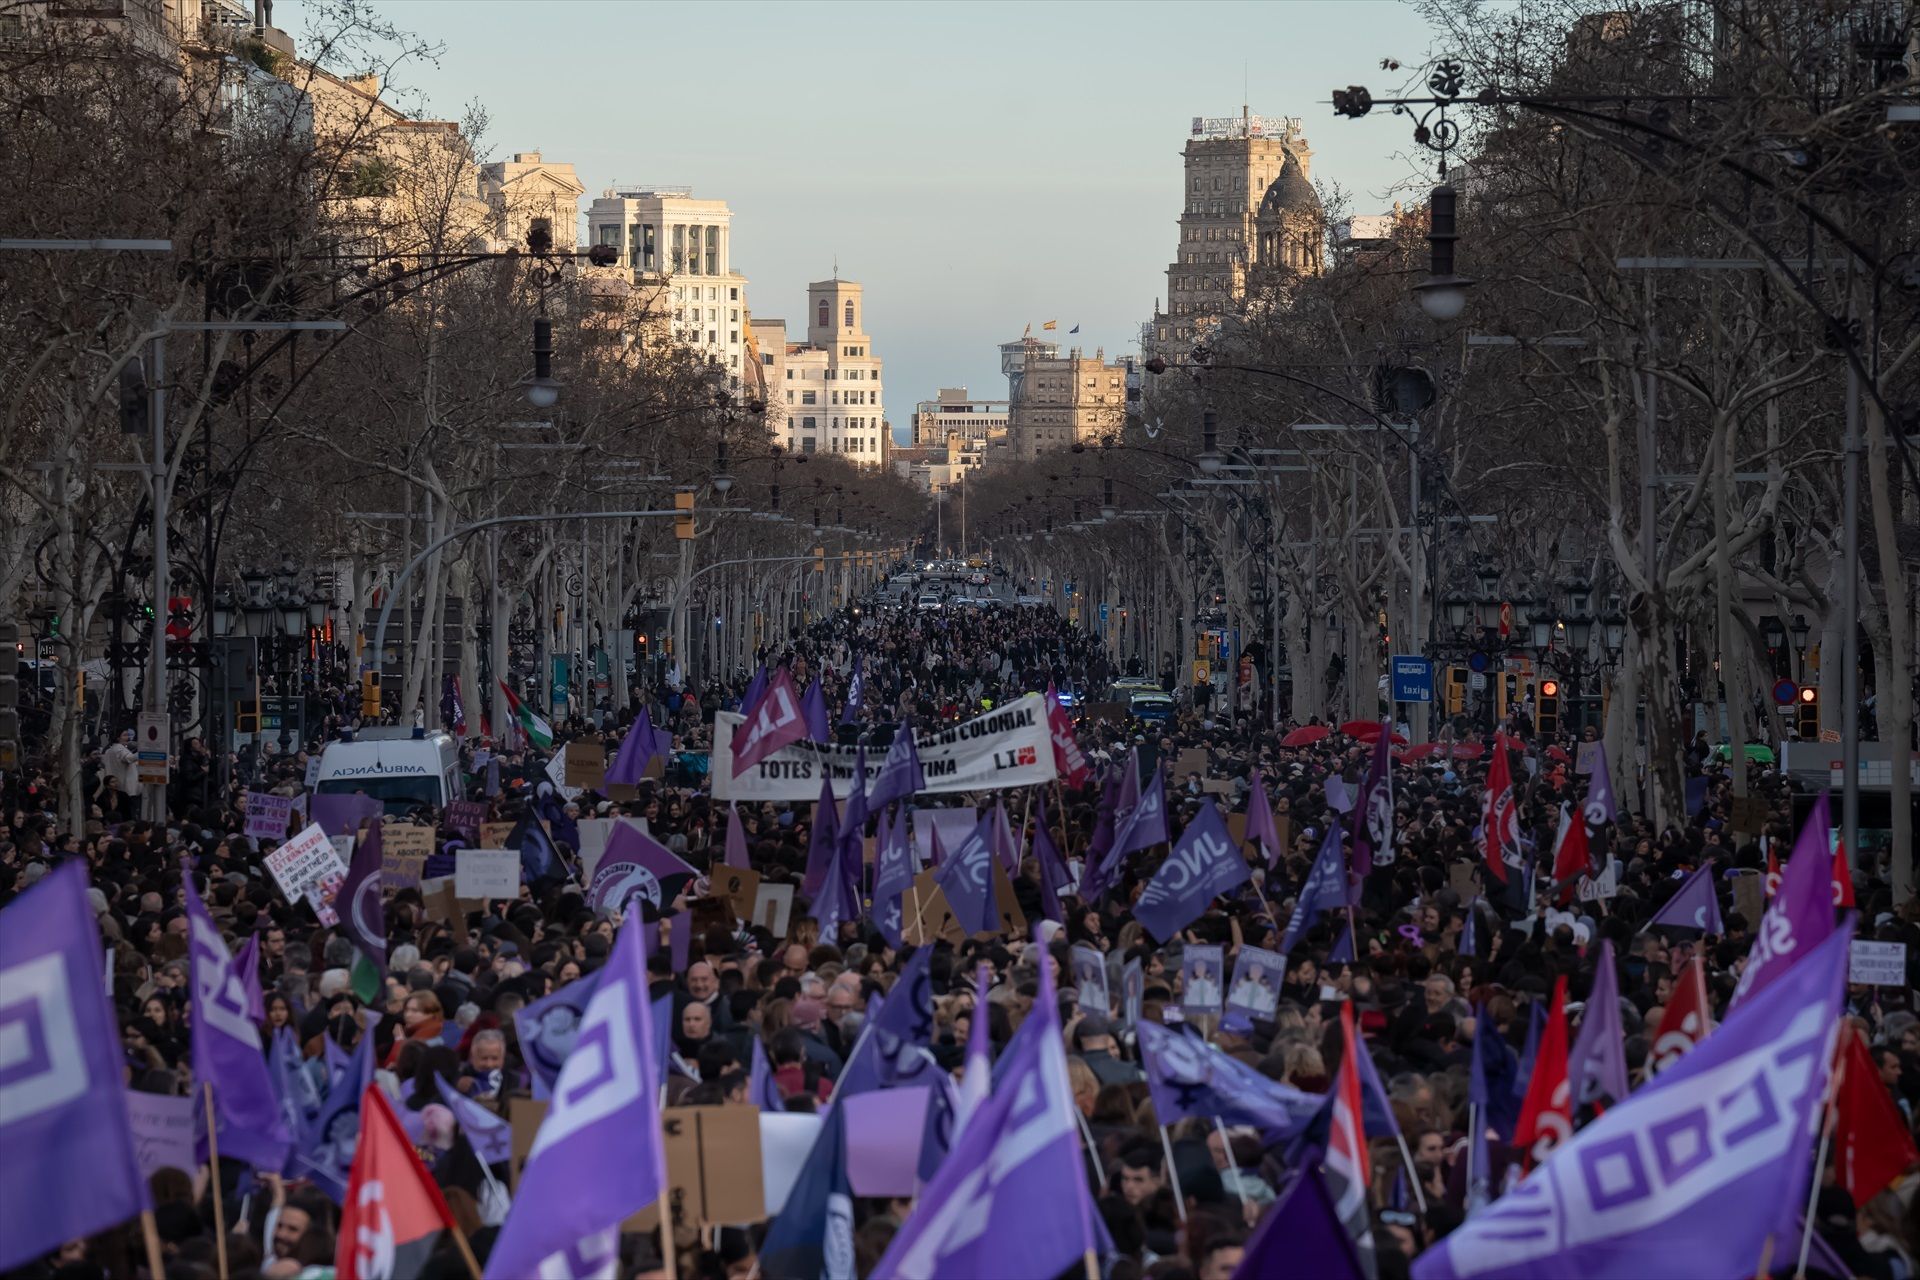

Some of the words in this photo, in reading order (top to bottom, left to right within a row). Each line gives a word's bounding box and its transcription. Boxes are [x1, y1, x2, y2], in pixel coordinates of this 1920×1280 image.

[1403, 685, 1420, 695] taxi
[959, 707, 1036, 740] COLONIAL
[760, 761, 812, 779] TOTES
[450, 800, 481, 815] TODO
[268, 850, 283, 865] LEY
[289, 852, 329, 884] APARTHEID
